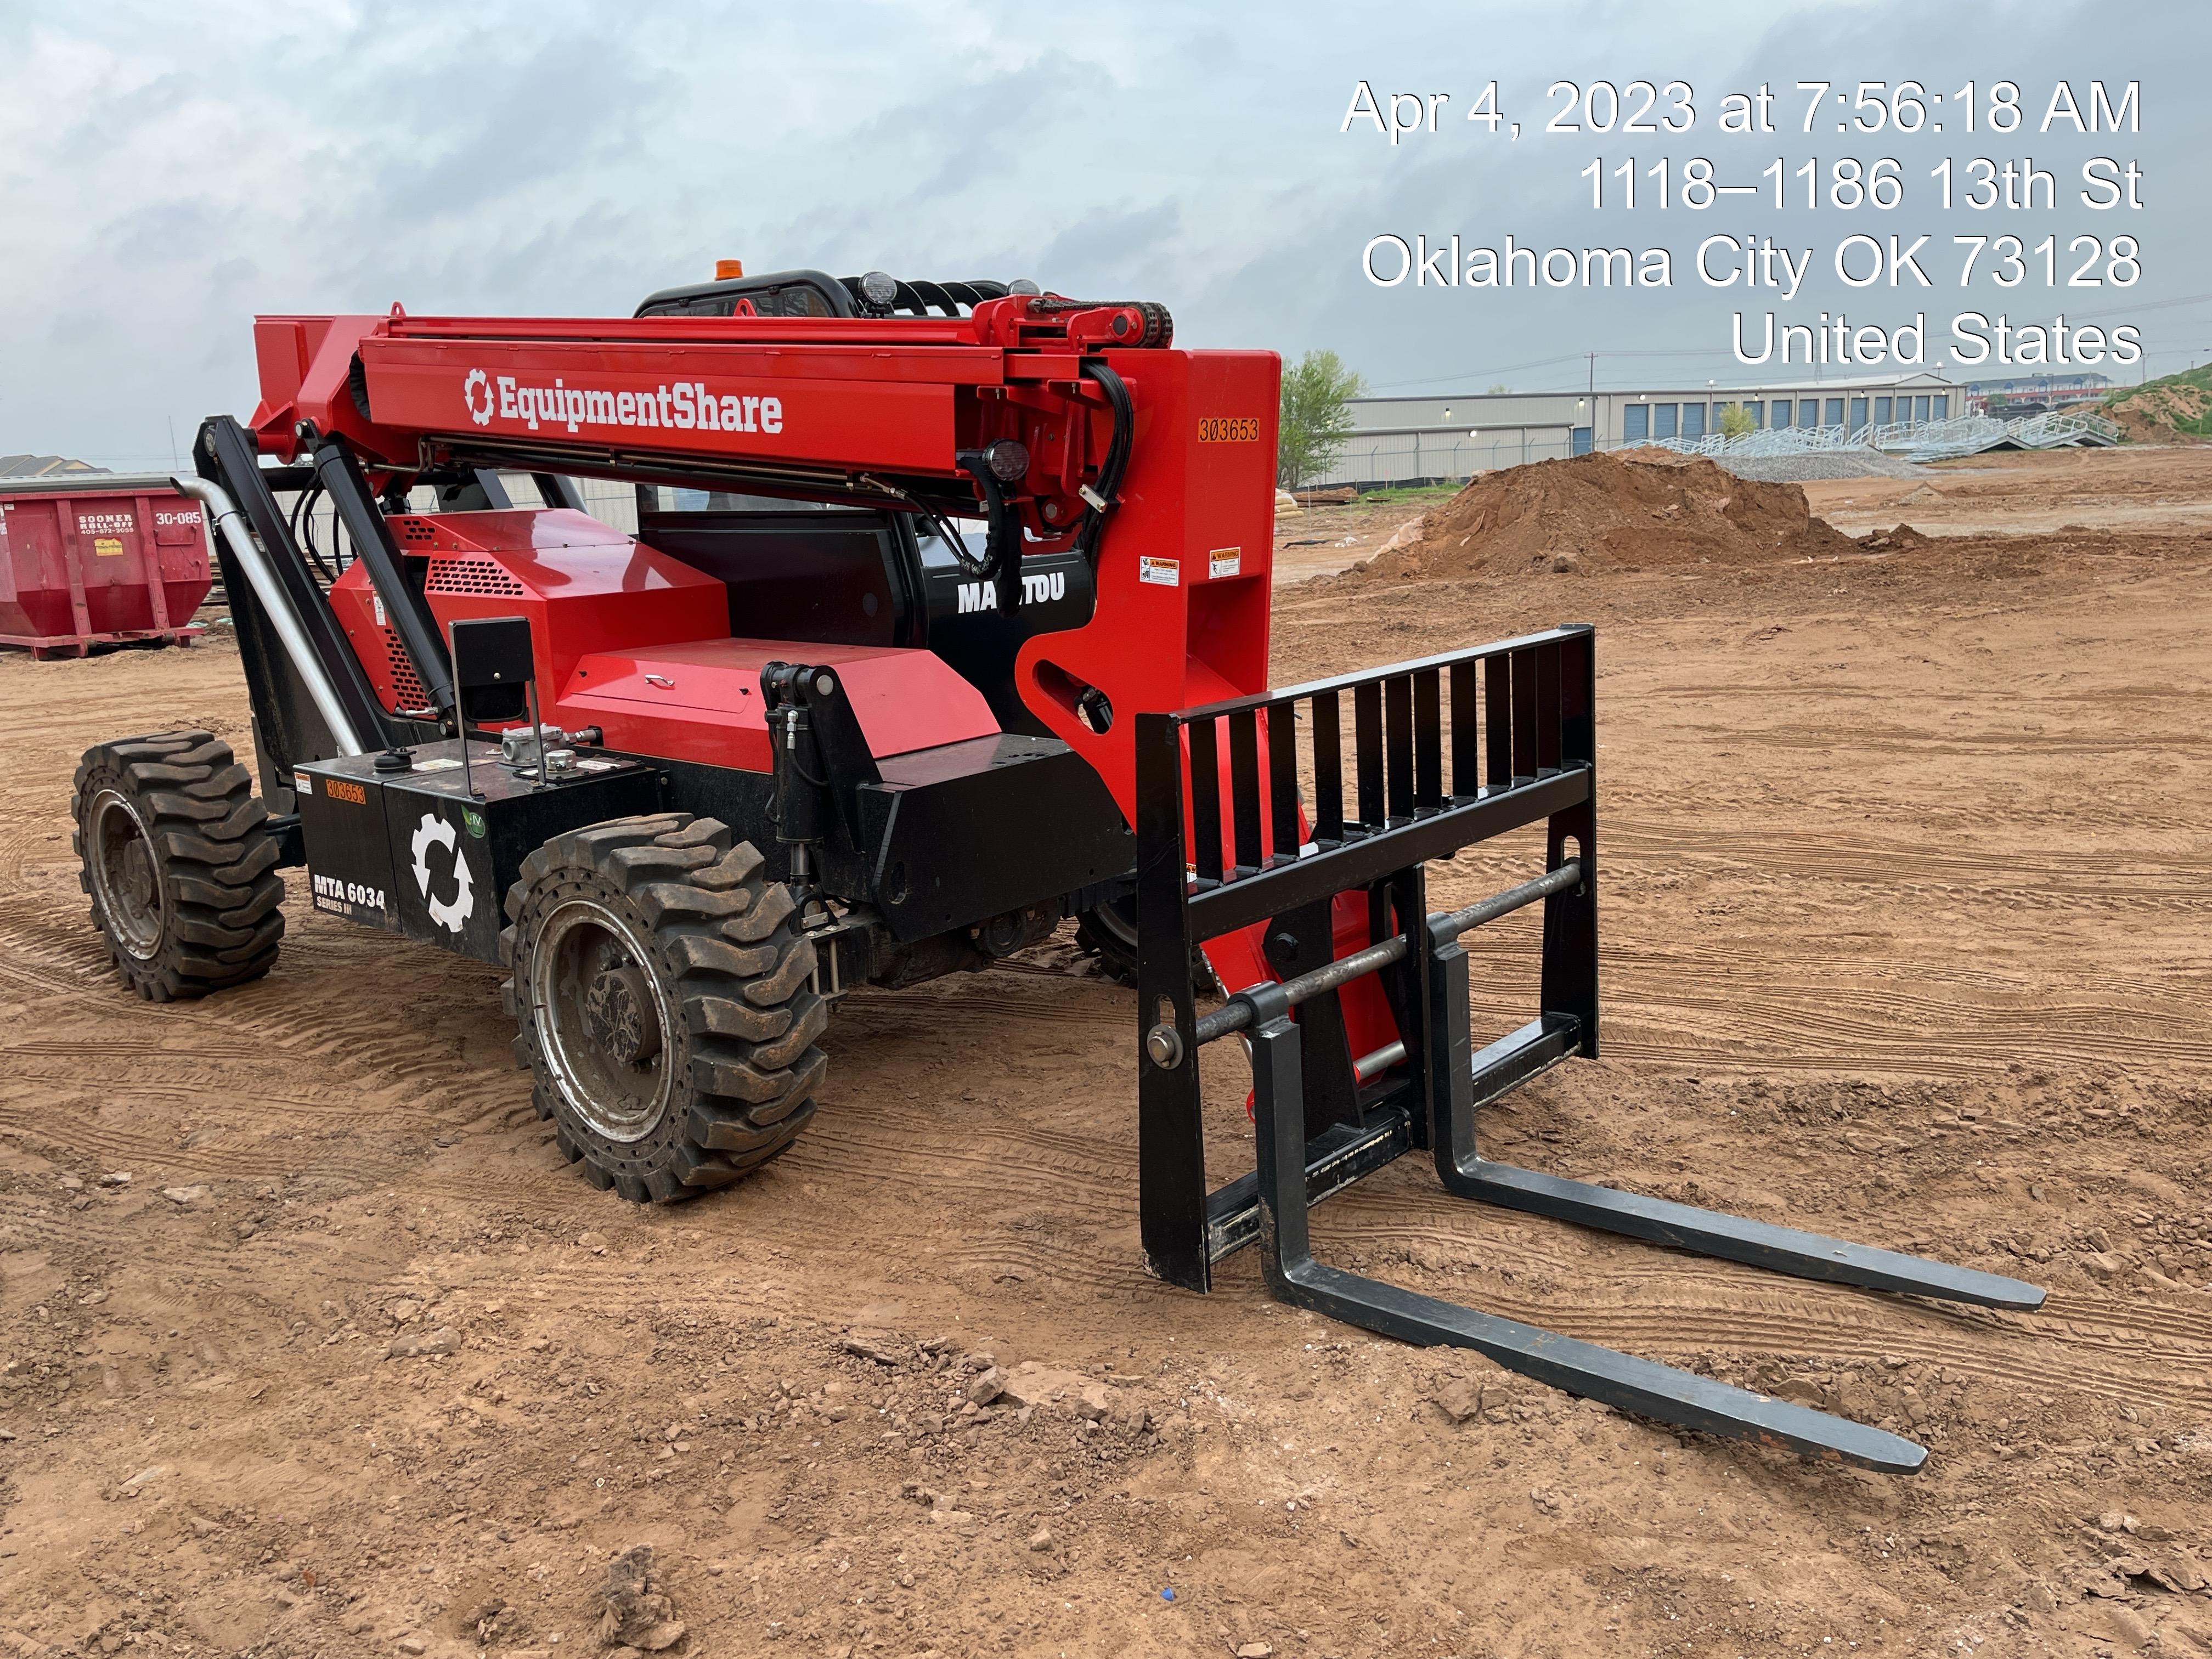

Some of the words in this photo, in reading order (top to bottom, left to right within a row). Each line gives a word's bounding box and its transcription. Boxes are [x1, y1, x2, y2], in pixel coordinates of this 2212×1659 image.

[496, 376, 783, 434] EquipmentShare
[1200, 419, 1259, 441] 303653
[78, 514, 132, 523] SOONER
[155, 511, 201, 525] 30-085
[957, 572, 1065, 614] MATOU
[327, 780, 364, 803] 303653
[314, 874, 346, 900] MTA
[347, 883, 385, 910] 6034
[317, 896, 343, 913] SERIES
